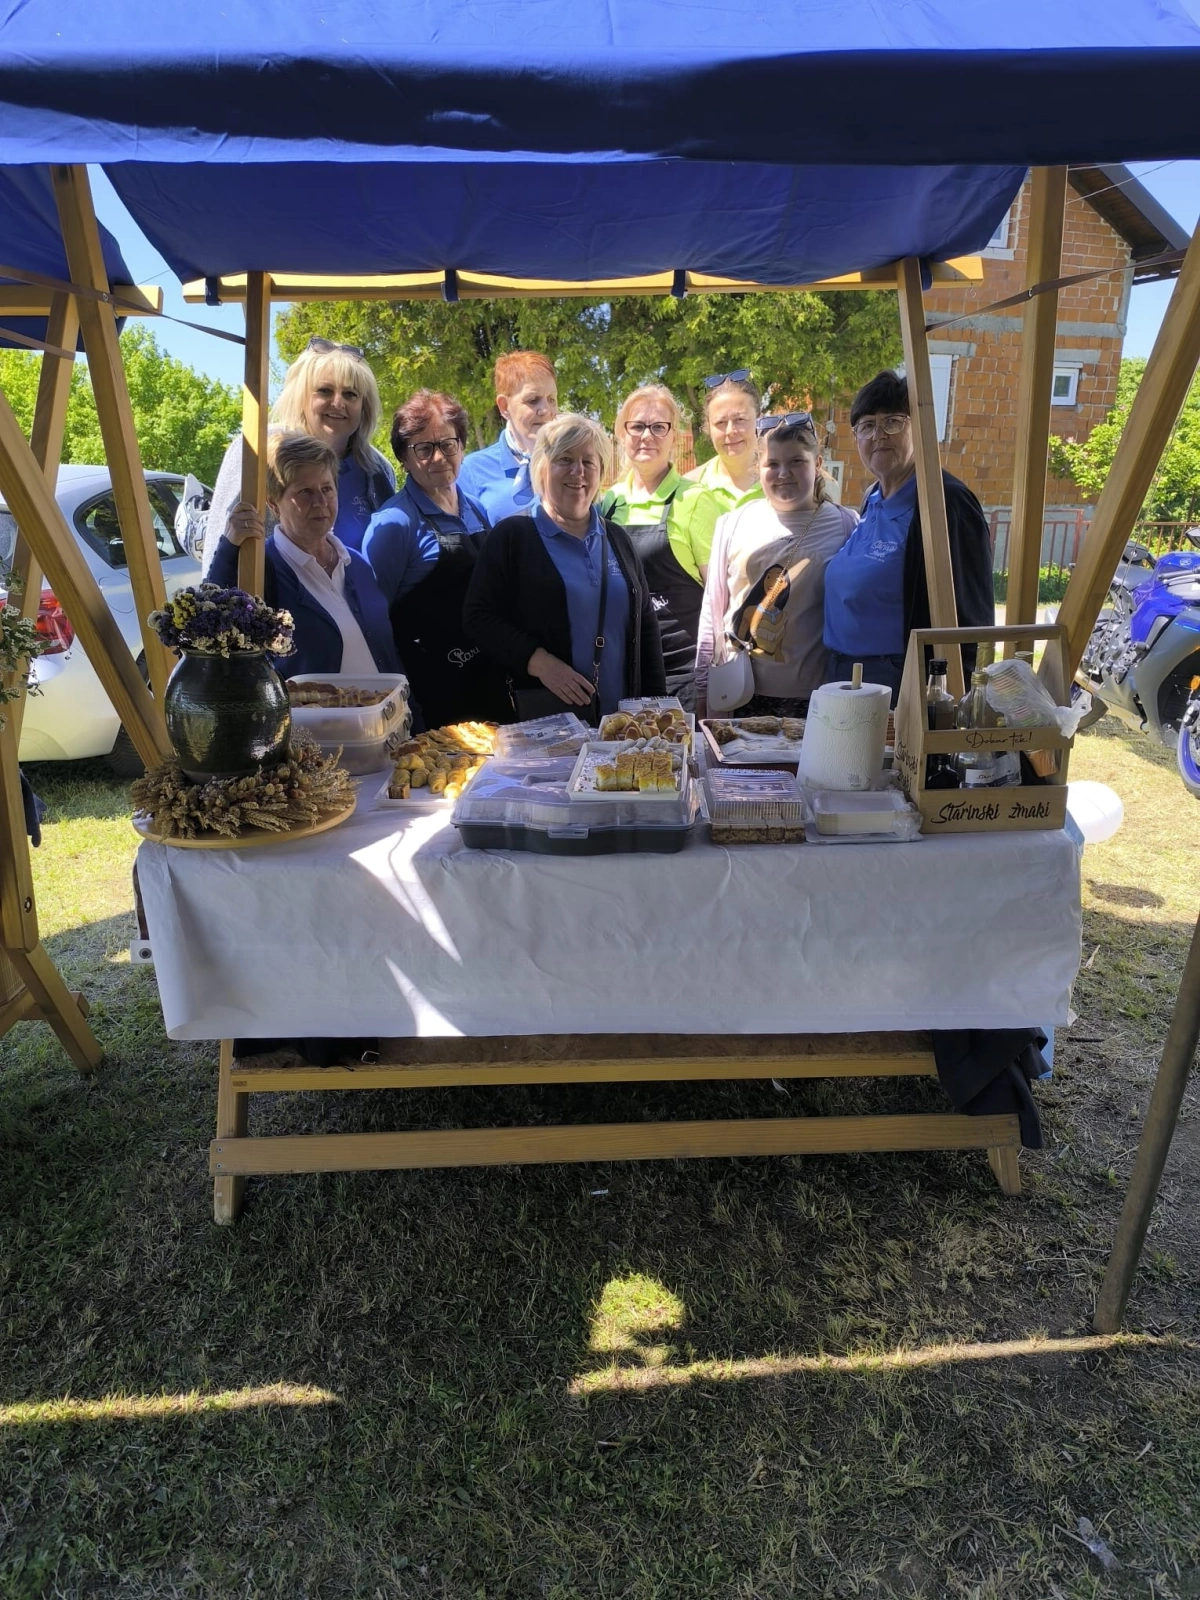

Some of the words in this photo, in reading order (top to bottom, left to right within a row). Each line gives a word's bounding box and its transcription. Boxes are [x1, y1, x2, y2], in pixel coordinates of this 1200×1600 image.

[447, 645, 481, 668] Stari
[966, 731, 1008, 748] Dobar
[930, 801, 1001, 824] Starinski
